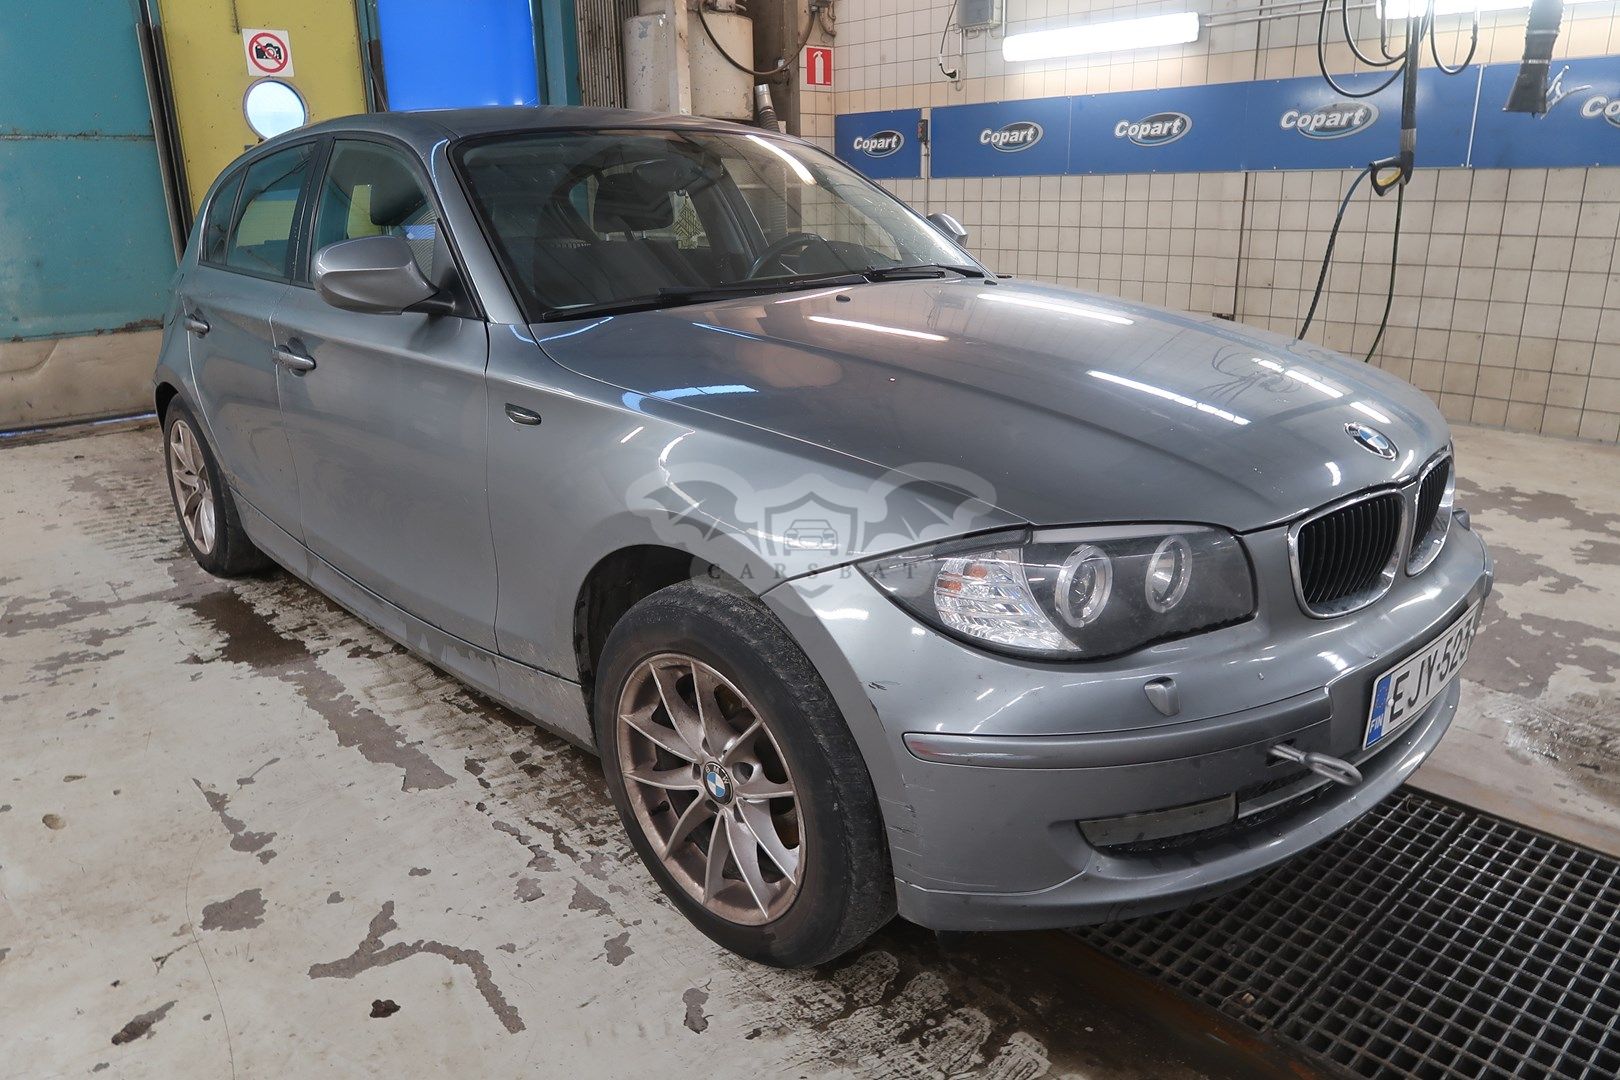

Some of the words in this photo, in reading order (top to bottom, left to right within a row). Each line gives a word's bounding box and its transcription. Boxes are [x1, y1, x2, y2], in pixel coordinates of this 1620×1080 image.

[1115, 118, 1182, 140] Copart
[1280, 106, 1364, 131] Copart
[853, 135, 897, 153] Copart
[979, 125, 1034, 146] Copart
[1368, 713, 1385, 734] FIN
